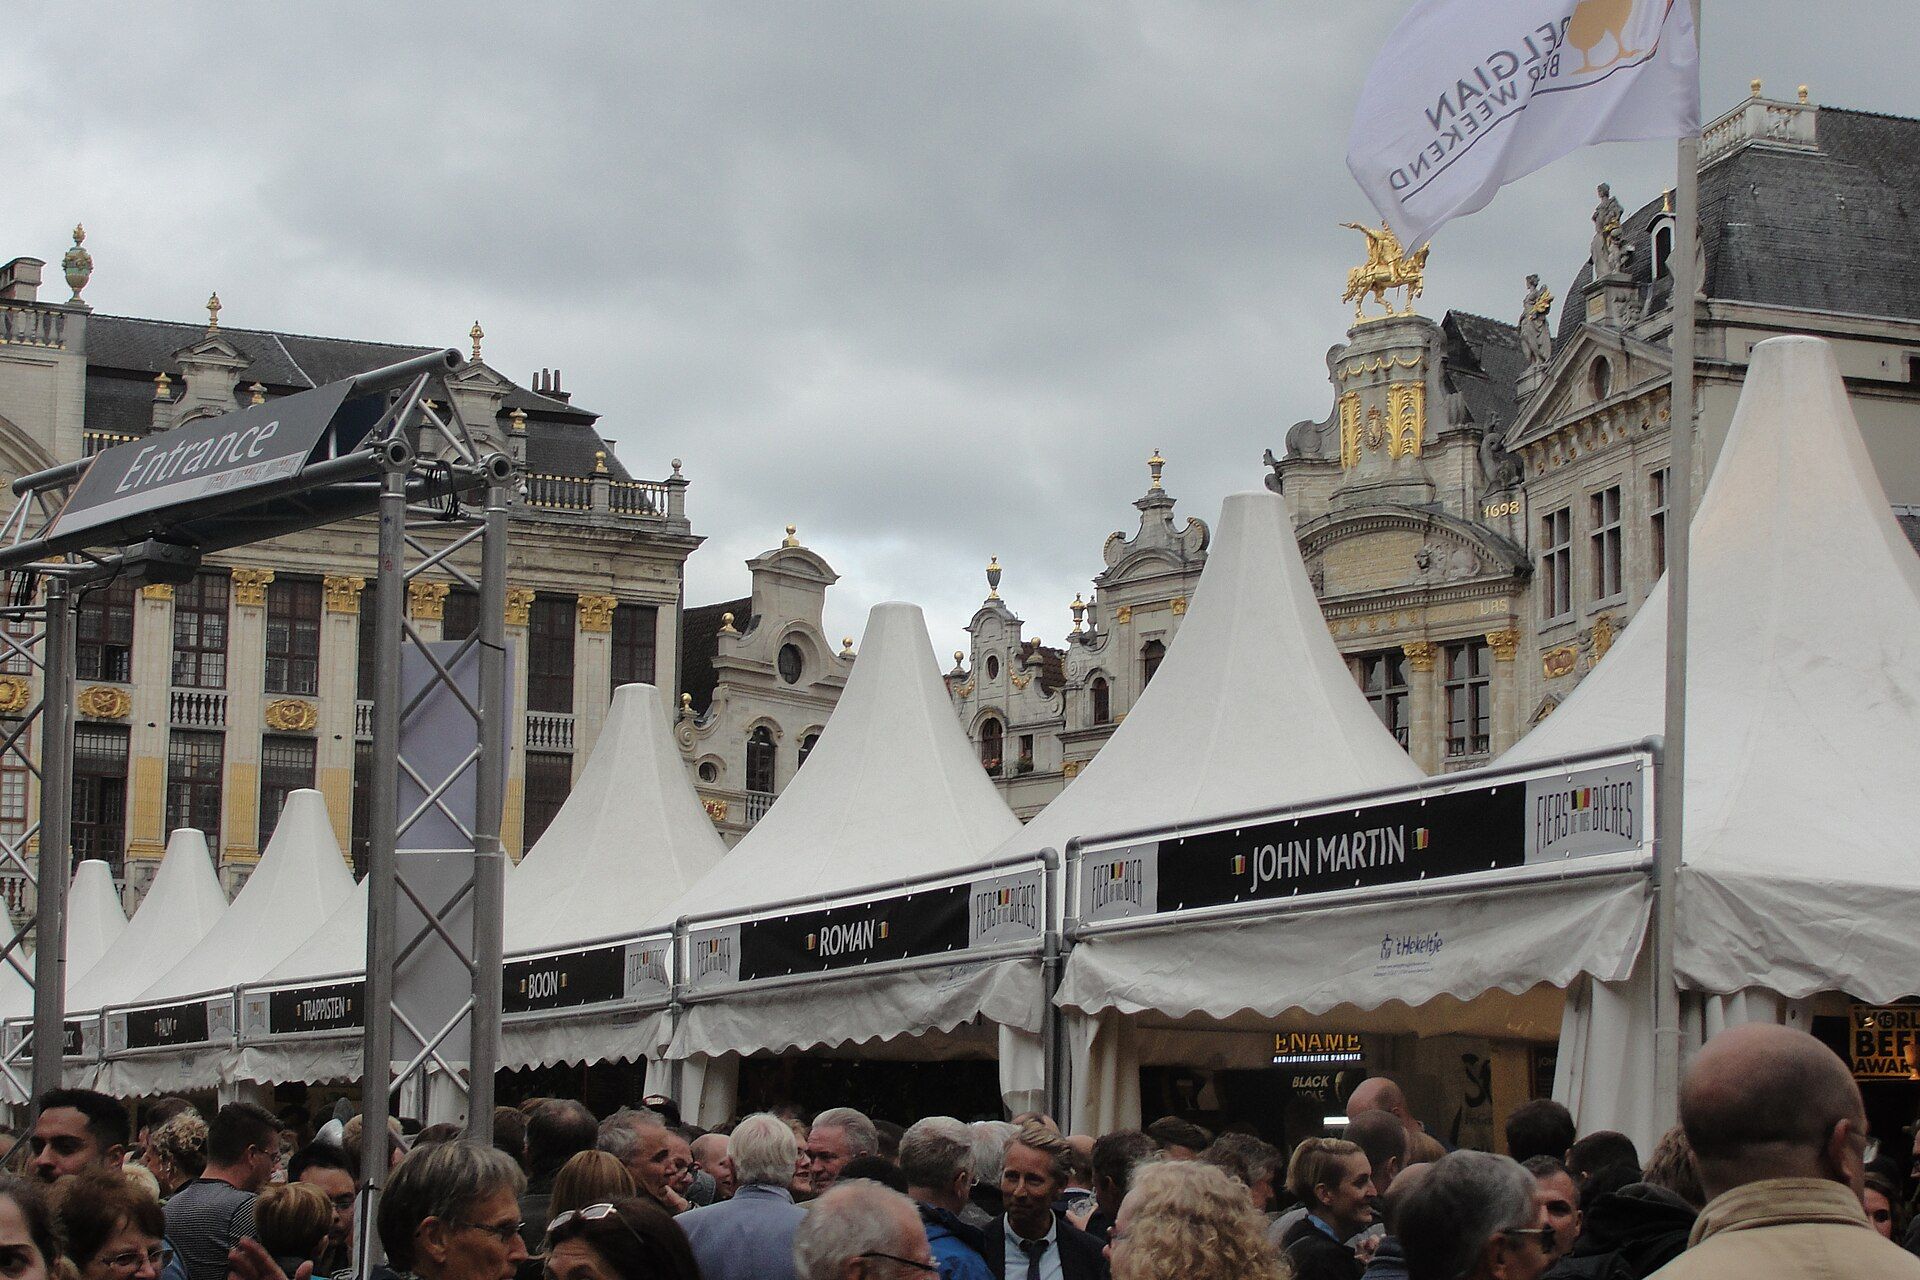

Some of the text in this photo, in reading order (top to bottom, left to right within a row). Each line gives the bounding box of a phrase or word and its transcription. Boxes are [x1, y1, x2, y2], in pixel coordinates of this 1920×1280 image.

[114, 420, 280, 495] Entrance
[1483, 501, 1520, 519] 1698
[1536, 792, 1569, 854] FIERS
[1250, 824, 1405, 893] JOHN MARTIN
[819, 918, 876, 957] ROMAN
[528, 970, 559, 999] BOON
[302, 996, 346, 1022] TRAPPISTEN
[1275, 1033, 1361, 1053] ENAME
[1292, 1075, 1330, 1088] BLACK
